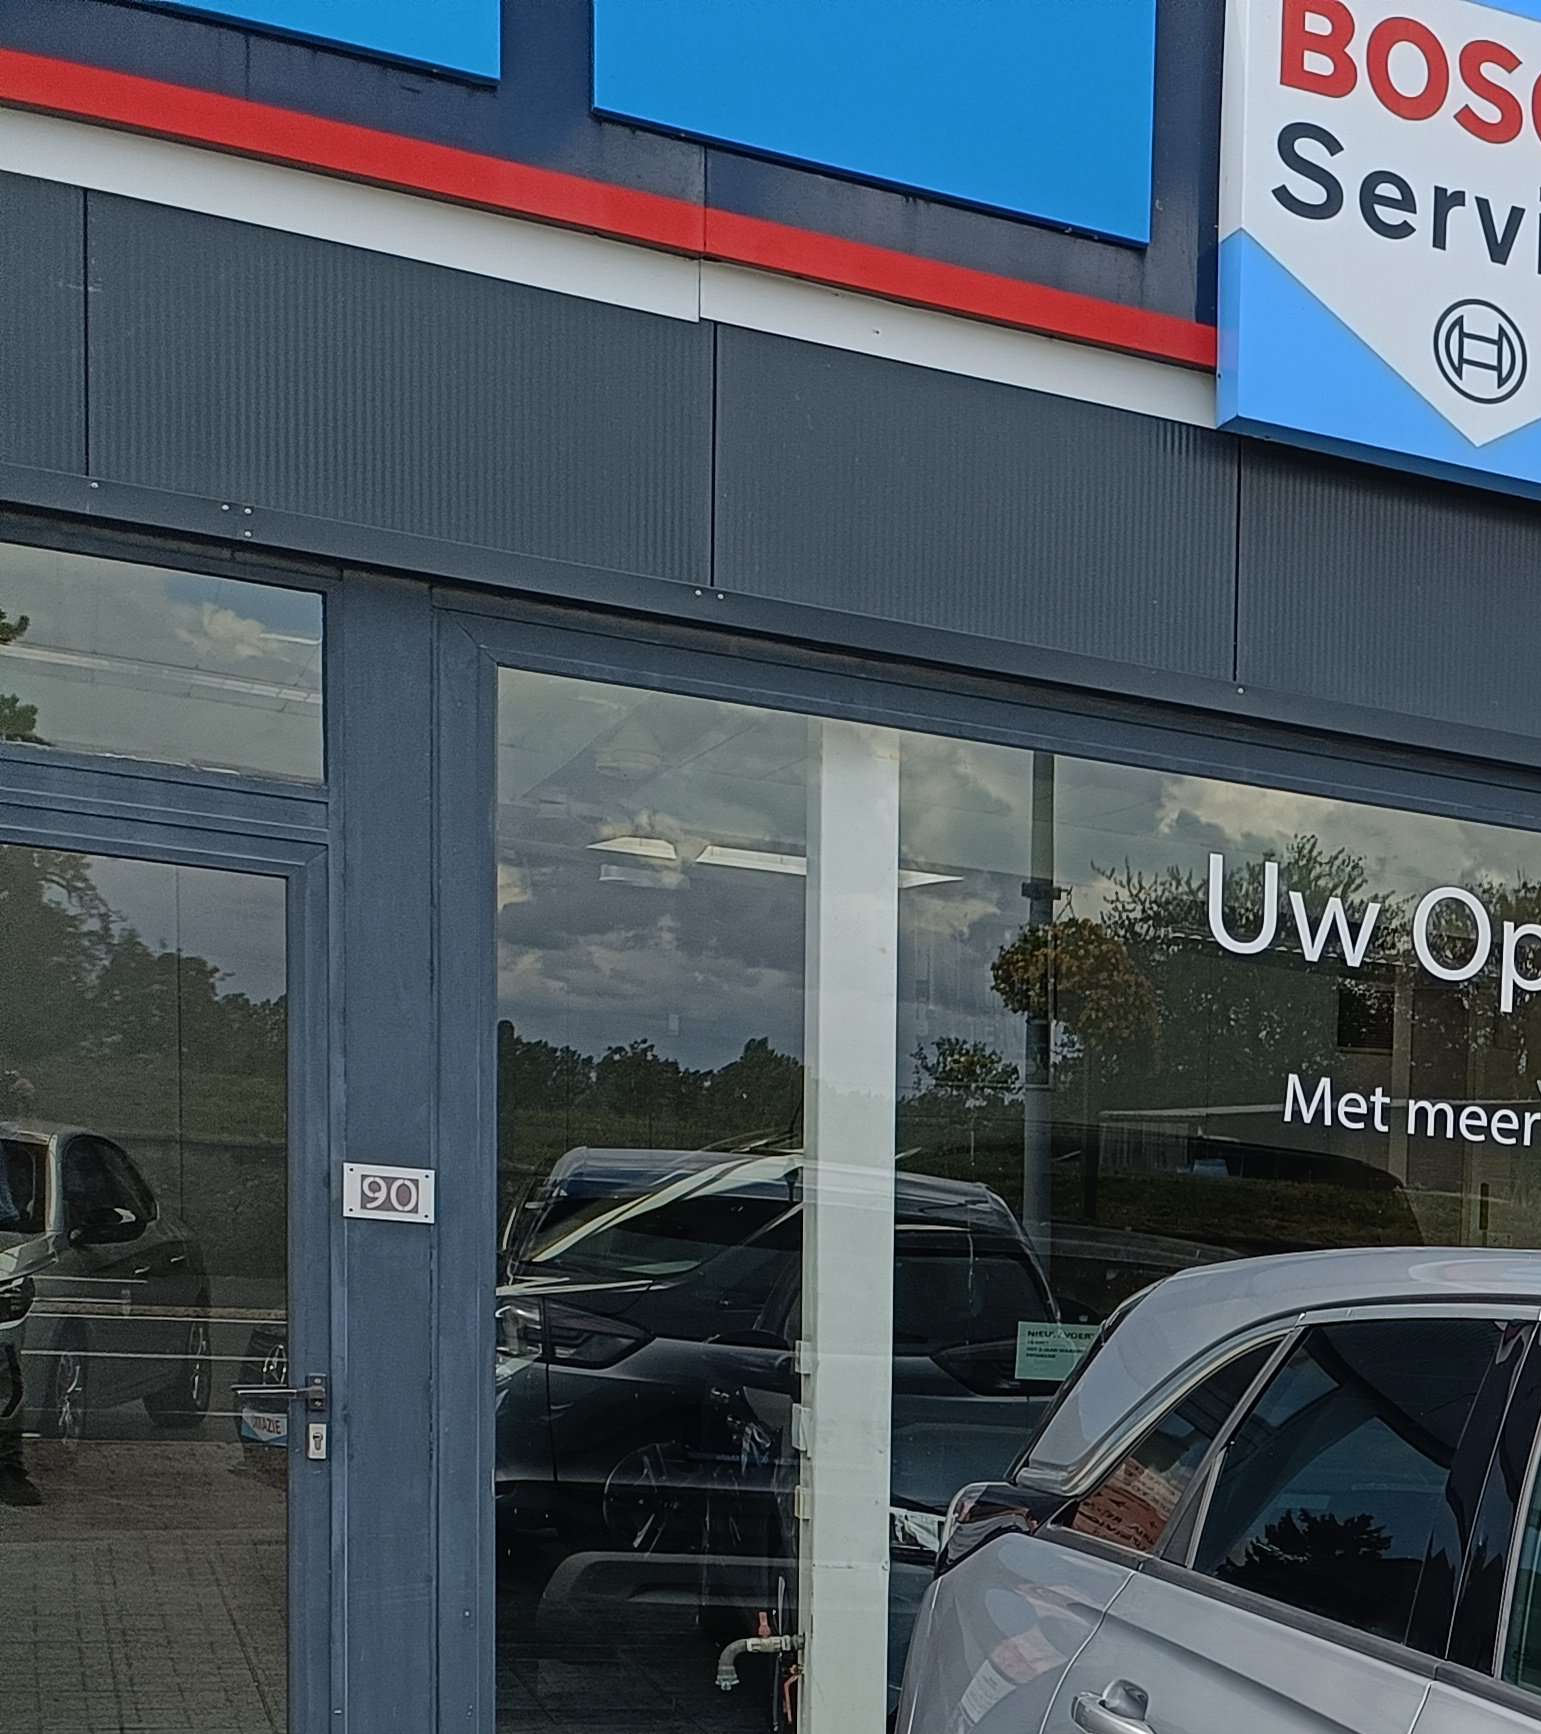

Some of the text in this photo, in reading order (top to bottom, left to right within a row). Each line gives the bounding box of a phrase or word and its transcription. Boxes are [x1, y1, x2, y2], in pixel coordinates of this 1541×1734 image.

[1208, 853, 1380, 967] Uw
[1283, 1073, 1391, 1135] Met
[1406, 1101, 1541, 1148] meer
[362, 1176, 418, 1212] 90
